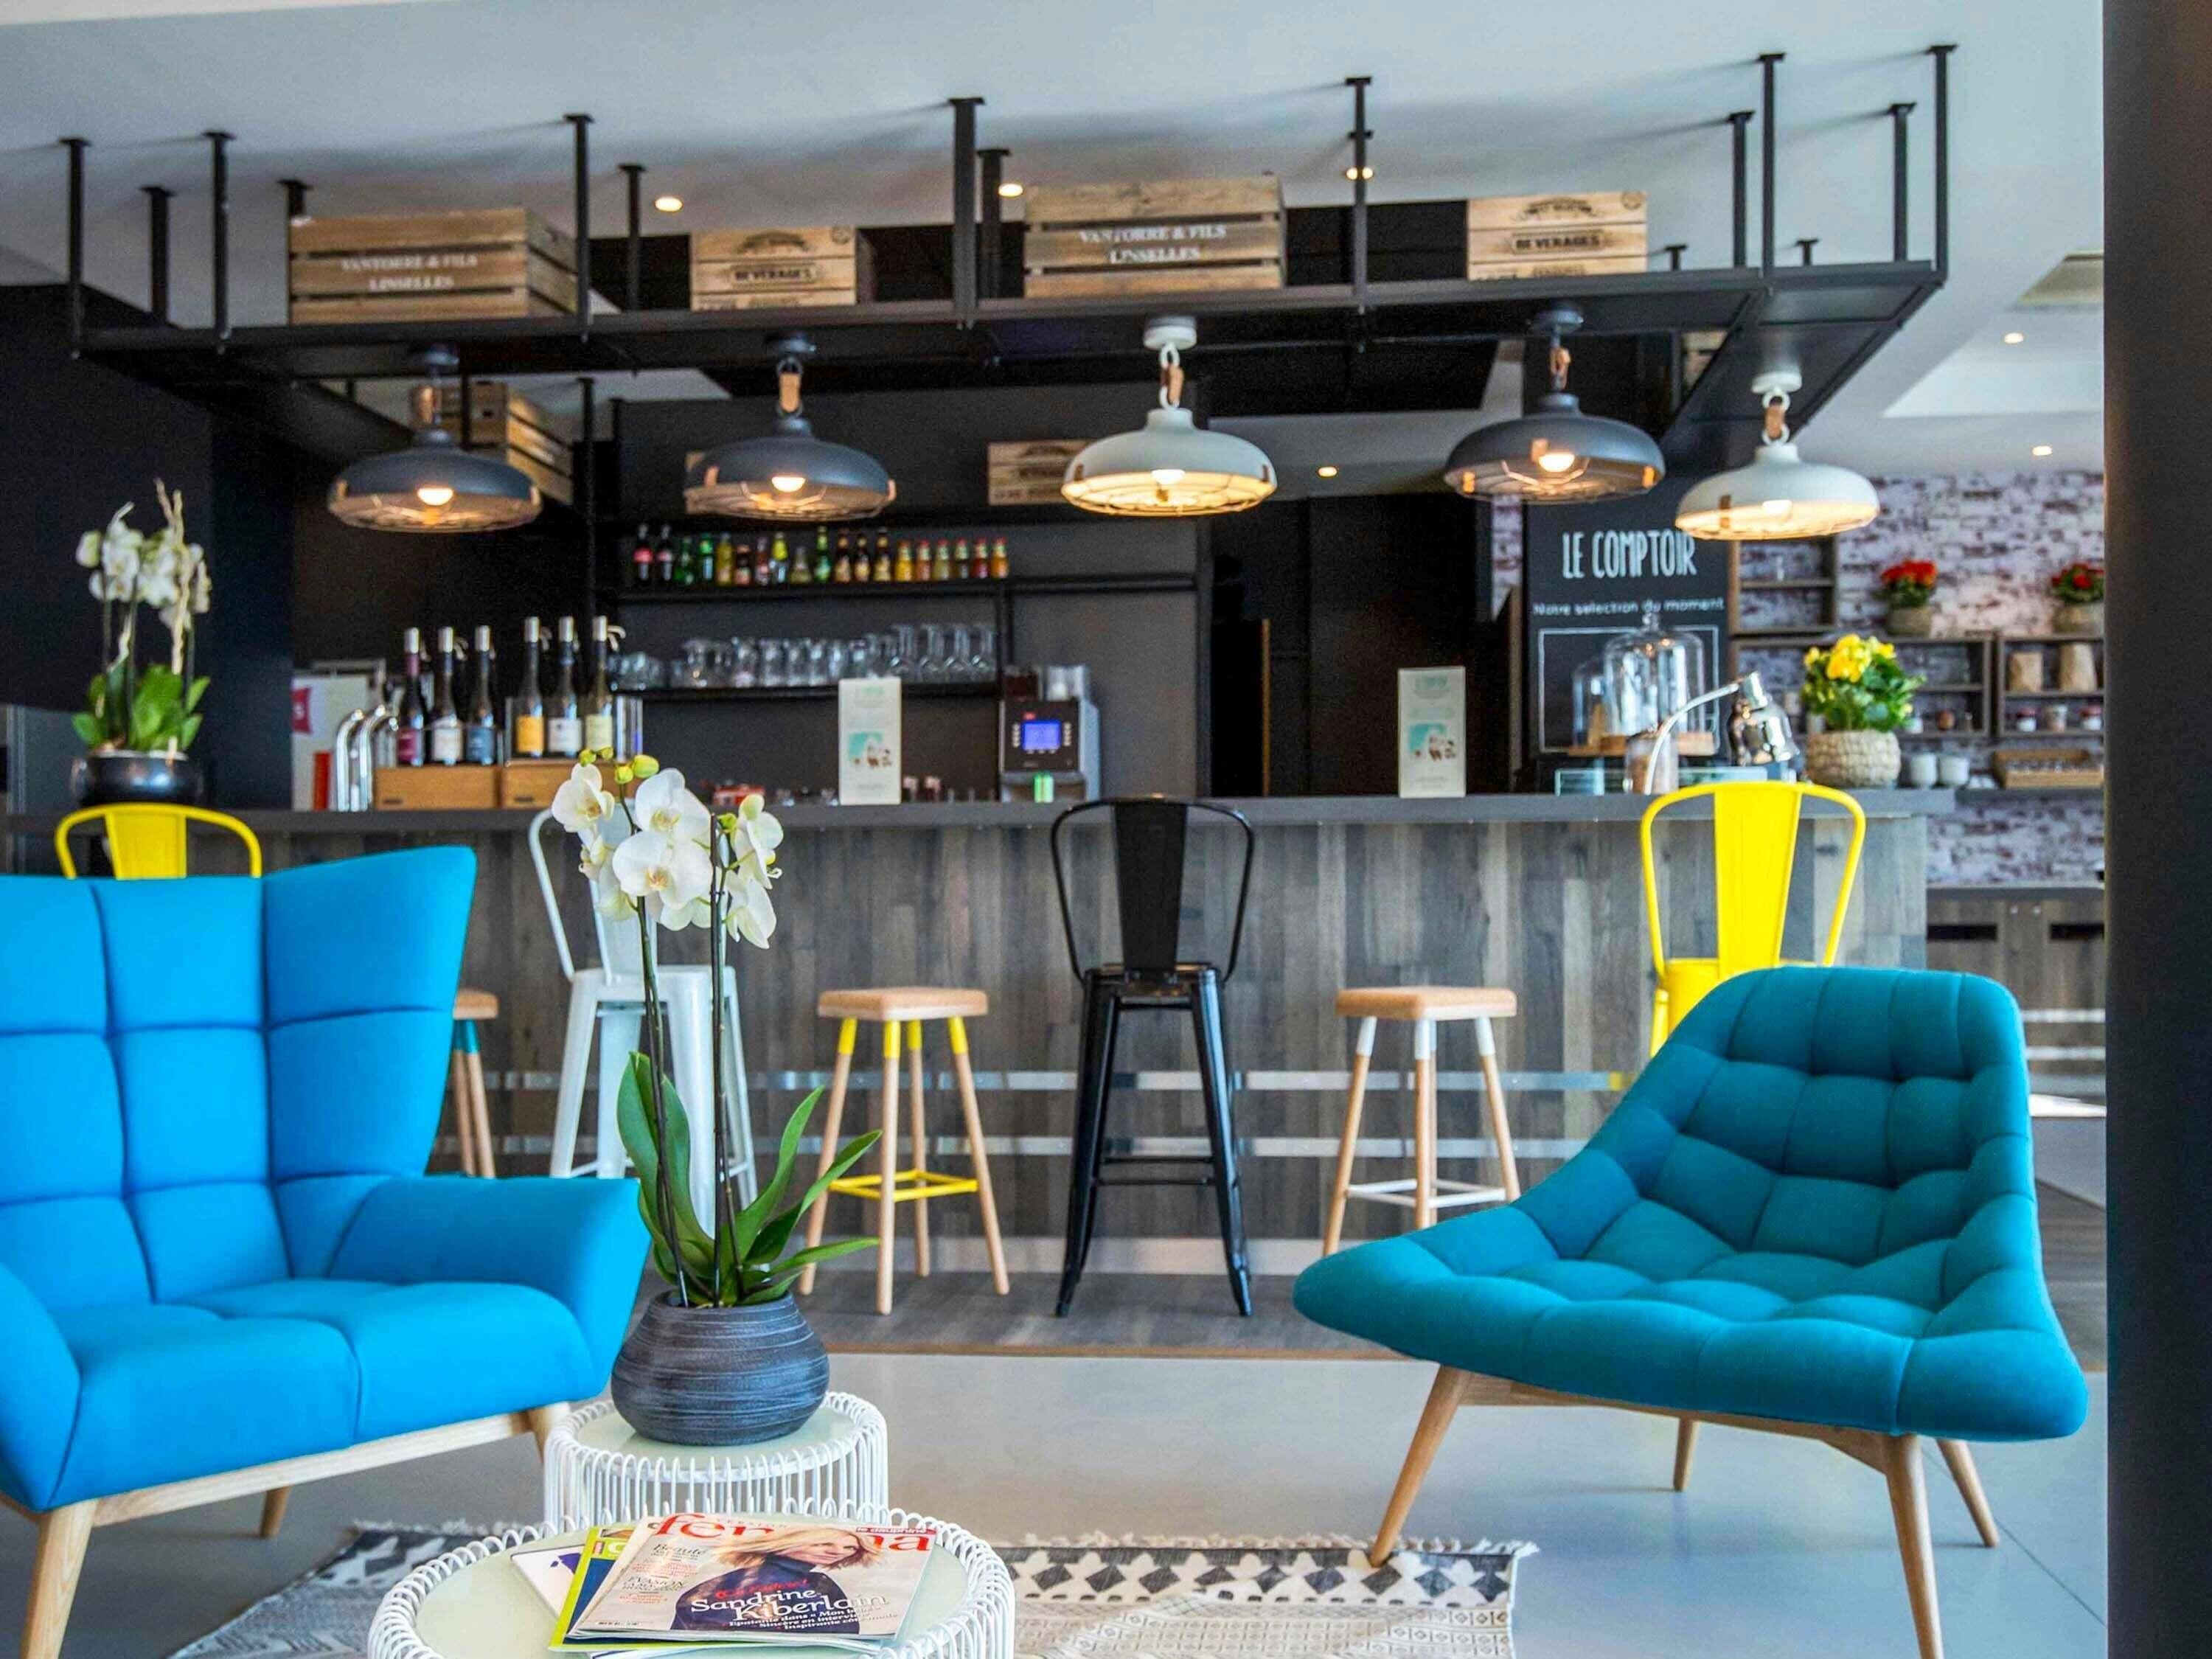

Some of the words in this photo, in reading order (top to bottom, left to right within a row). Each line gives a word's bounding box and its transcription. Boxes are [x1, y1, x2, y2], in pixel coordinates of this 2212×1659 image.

[1562, 530, 1585, 580] LE
[1591, 528, 1697, 579] COMPTOIR
[1641, 597, 1661, 614] du
[1663, 596, 1725, 612] moment
[691, 1589, 816, 1613] Sandrine
